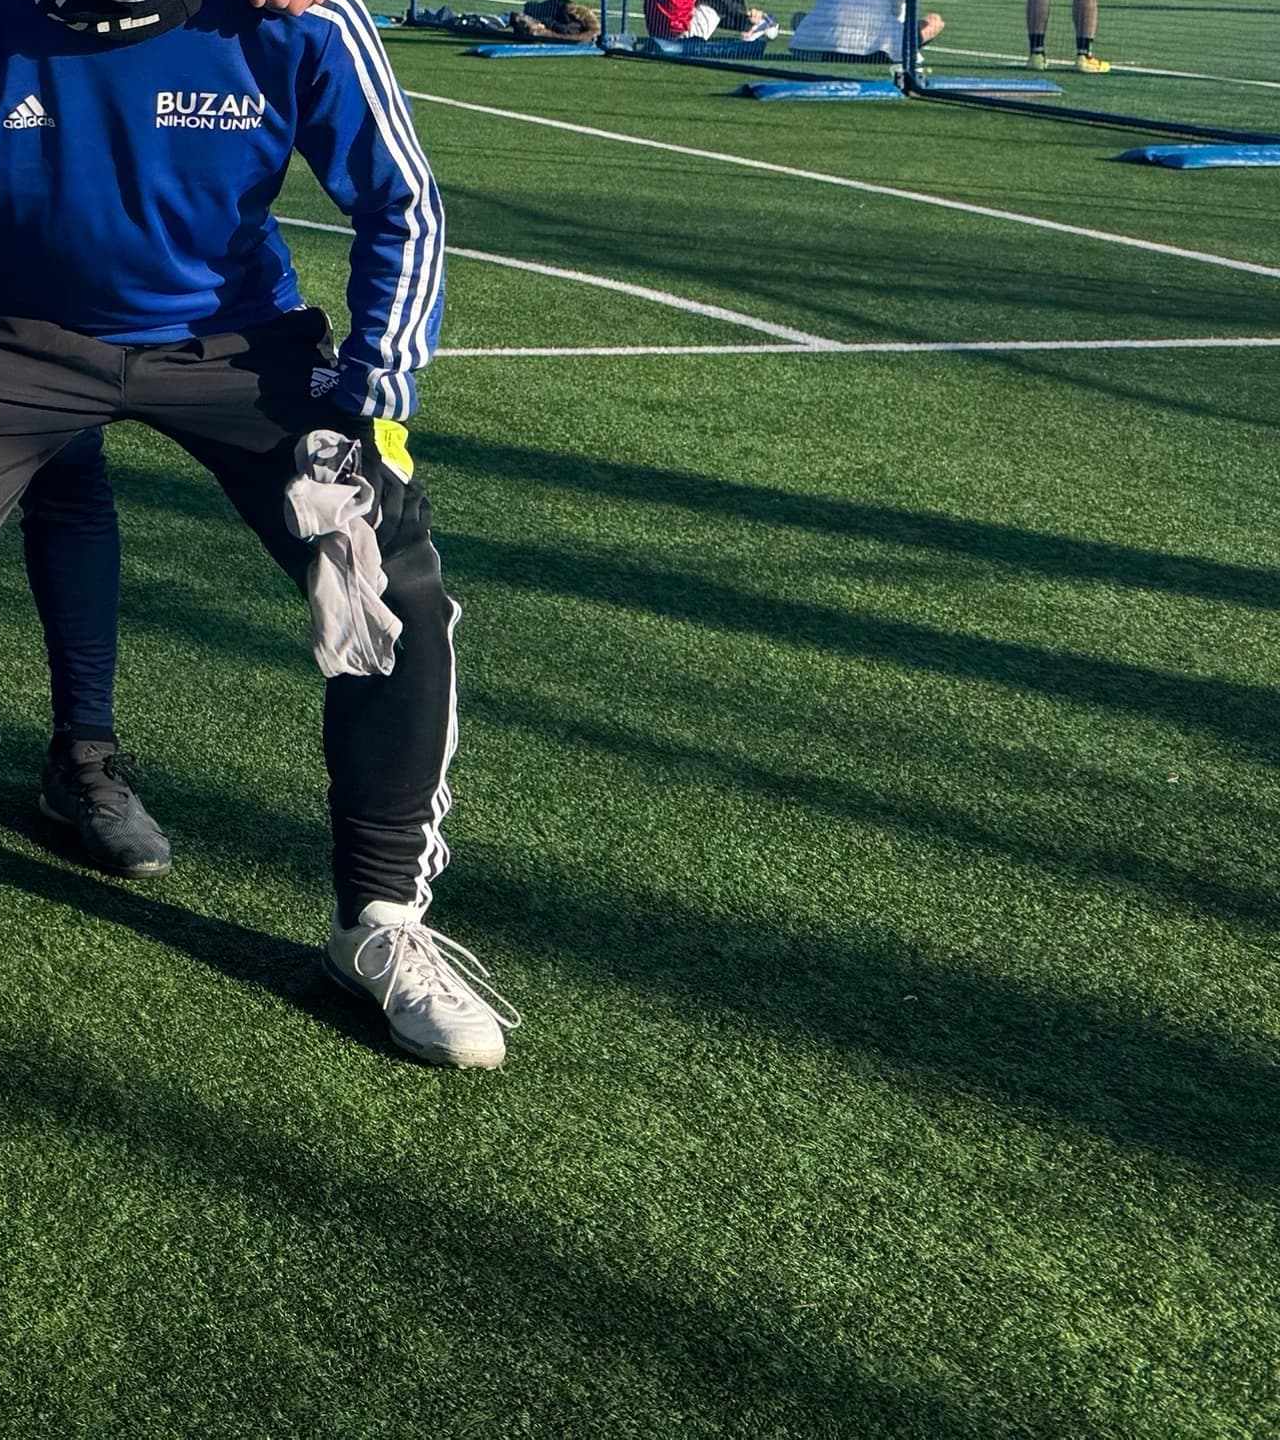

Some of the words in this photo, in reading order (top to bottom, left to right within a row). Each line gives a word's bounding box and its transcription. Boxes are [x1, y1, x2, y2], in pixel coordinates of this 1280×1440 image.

[156, 92, 266, 116] BUZAN
[3, 115, 56, 129] adidas
[156, 115, 214, 130] NIHON
[220, 116, 262, 131] UNIV.
